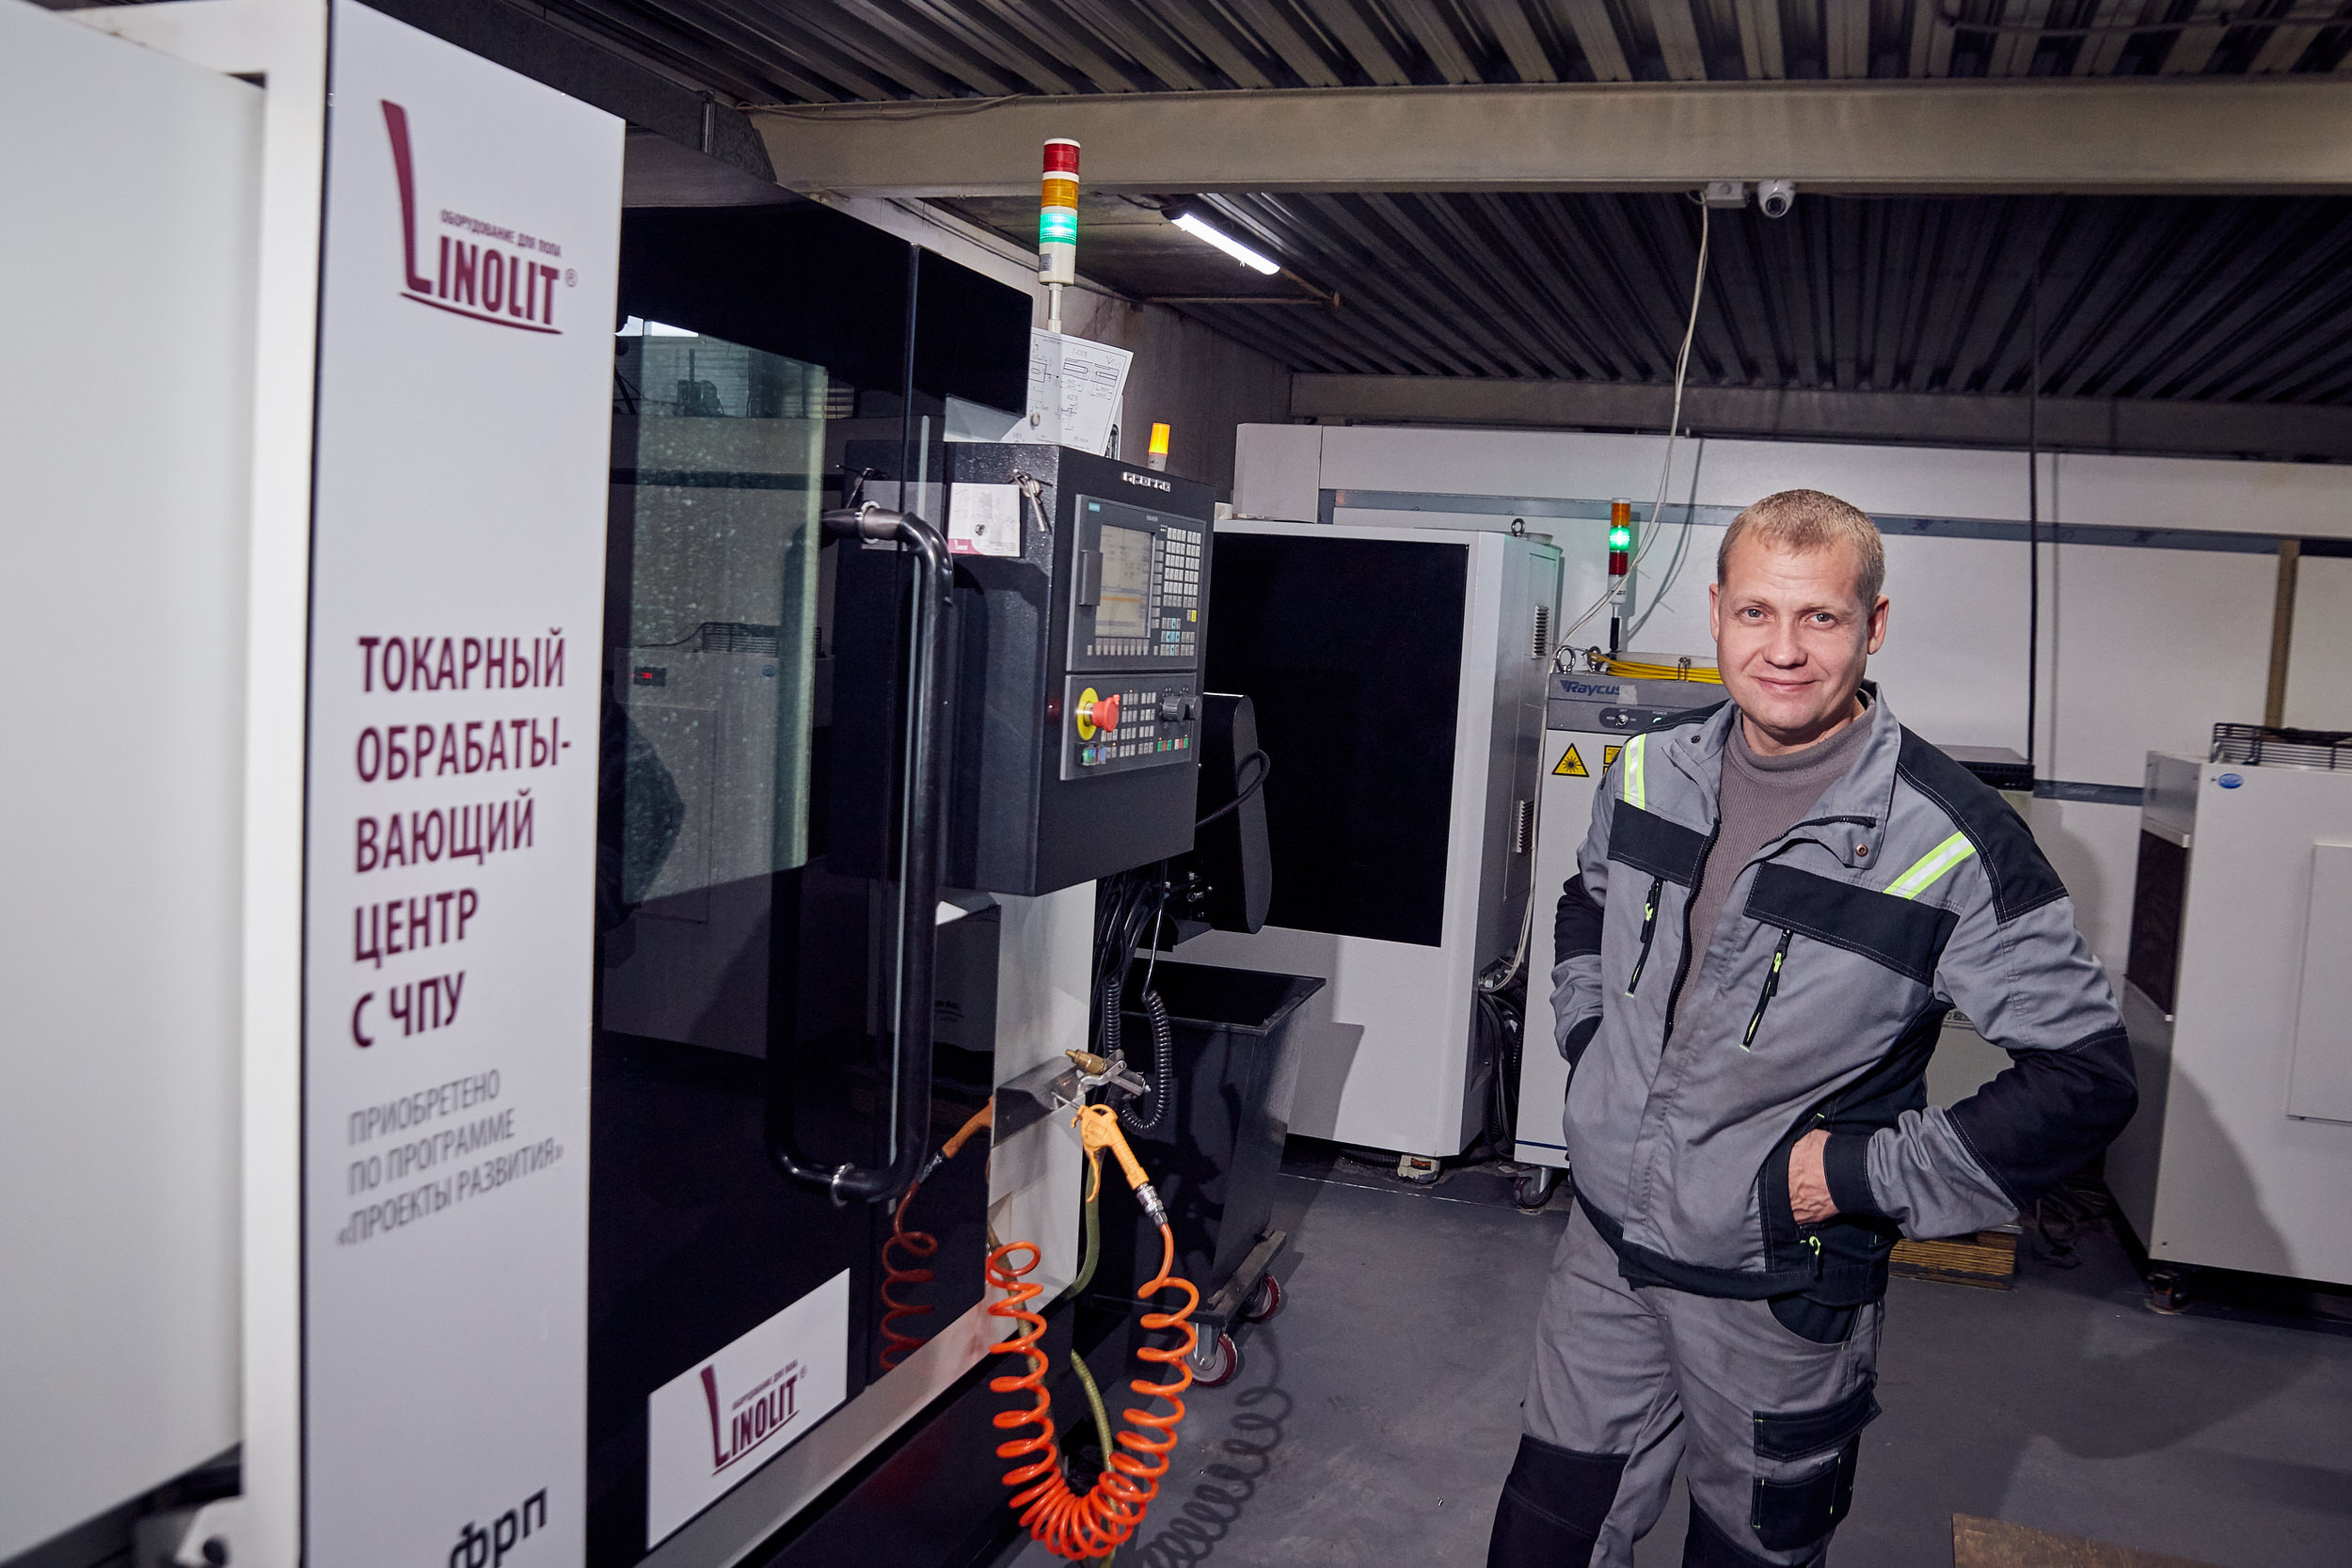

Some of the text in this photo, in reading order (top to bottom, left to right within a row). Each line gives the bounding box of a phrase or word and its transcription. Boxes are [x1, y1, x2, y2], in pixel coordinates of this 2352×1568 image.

[440, 209, 515, 244] ОБОРУДОВАНИЕ
[358, 626, 564, 692] ТОКАРНЫЙ
[357, 717, 571, 783] ОБРАБАТЫ-
[356, 788, 534, 873] ВАЮЩИЙ
[355, 888, 479, 970] ЦЕНТР
[353, 971, 466, 1048] С ЧПУ
[349, 1069, 501, 1146] ПРИОБРЕТЕНО
[349, 1107, 516, 1196] ПО ПРОГРАММЕ
[337, 1137, 564, 1245] «ПРОЕКТЫ РАЗВИТИЯ»
